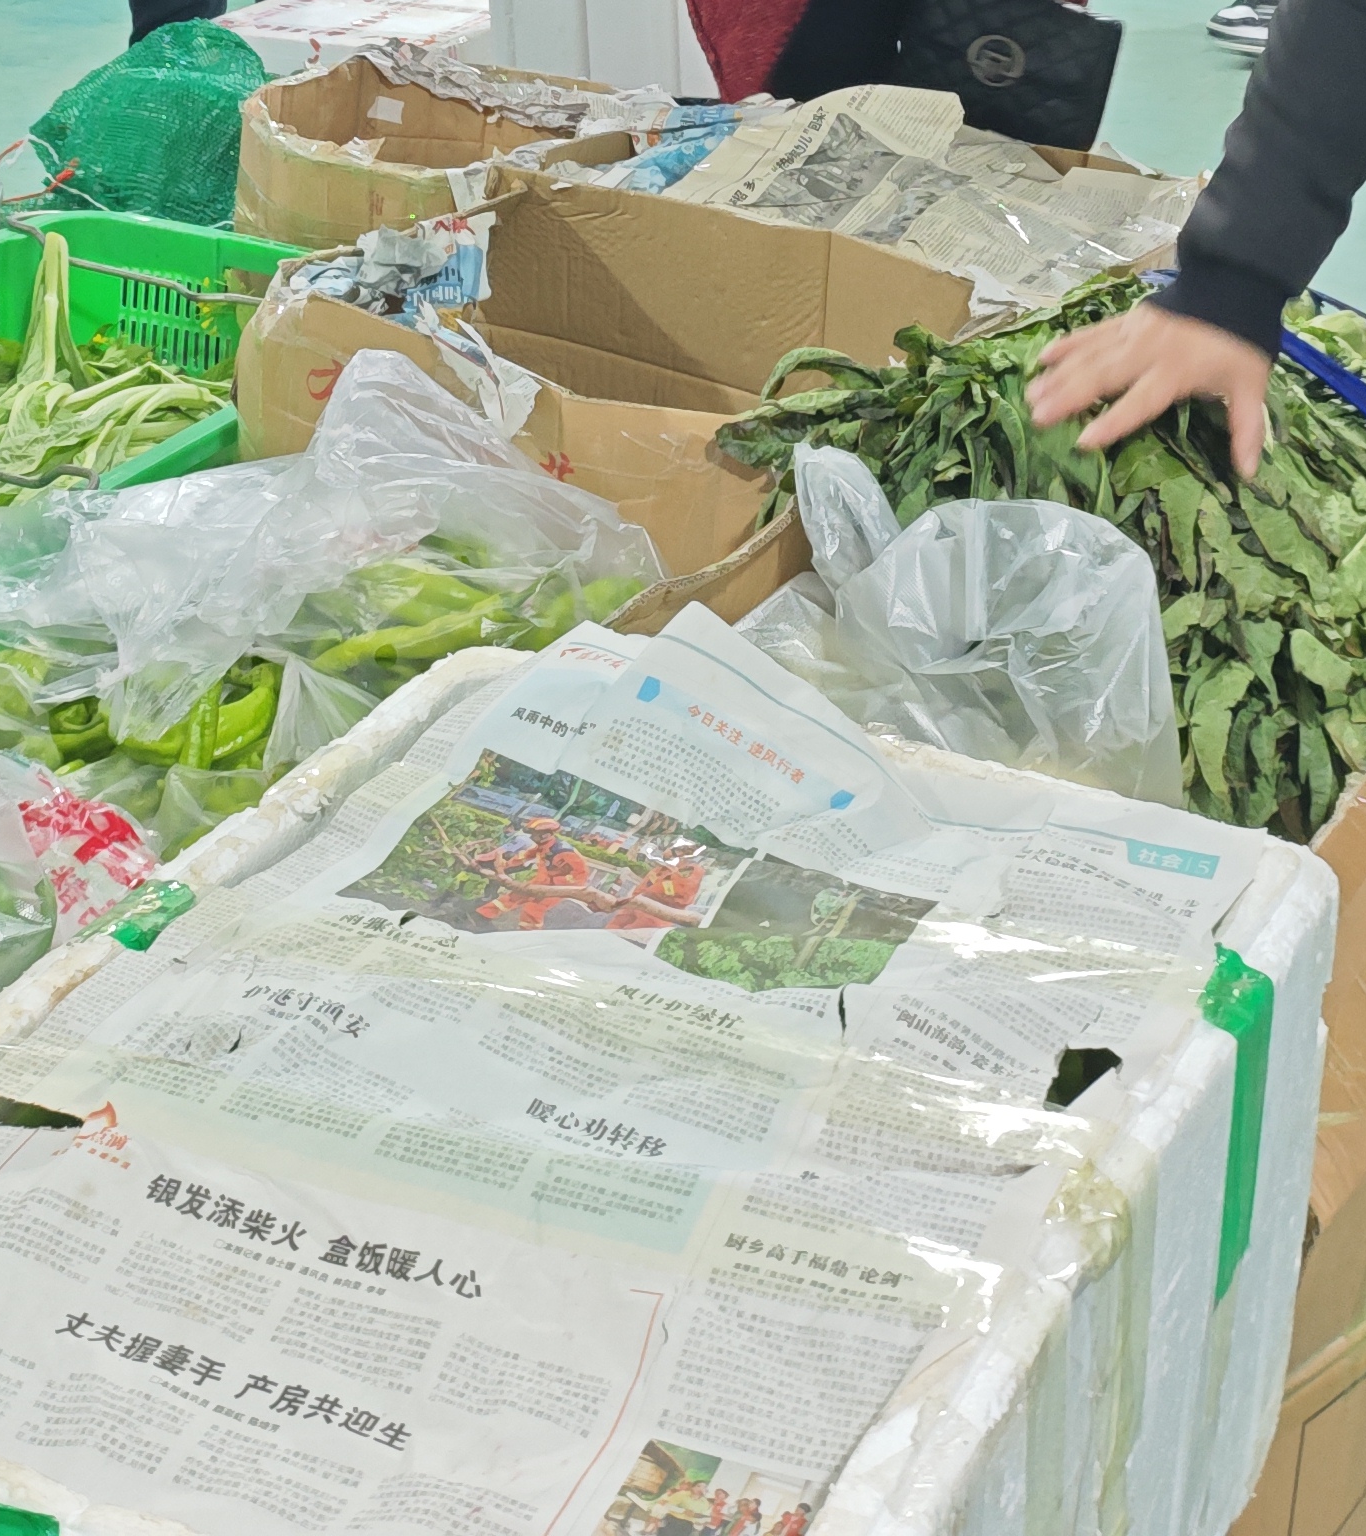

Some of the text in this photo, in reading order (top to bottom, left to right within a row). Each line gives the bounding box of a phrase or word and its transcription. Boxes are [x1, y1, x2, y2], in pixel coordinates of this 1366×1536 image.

[1137, 847, 1184, 870] 社会
[526, 1098, 667, 1157] 暖心劝转移
[146, 1173, 309, 1252] 银发添柴火
[318, 1235, 484, 1300] 盒饭暖人心
[55, 1312, 413, 1452] 丈夫握妻手 产房共迎生
